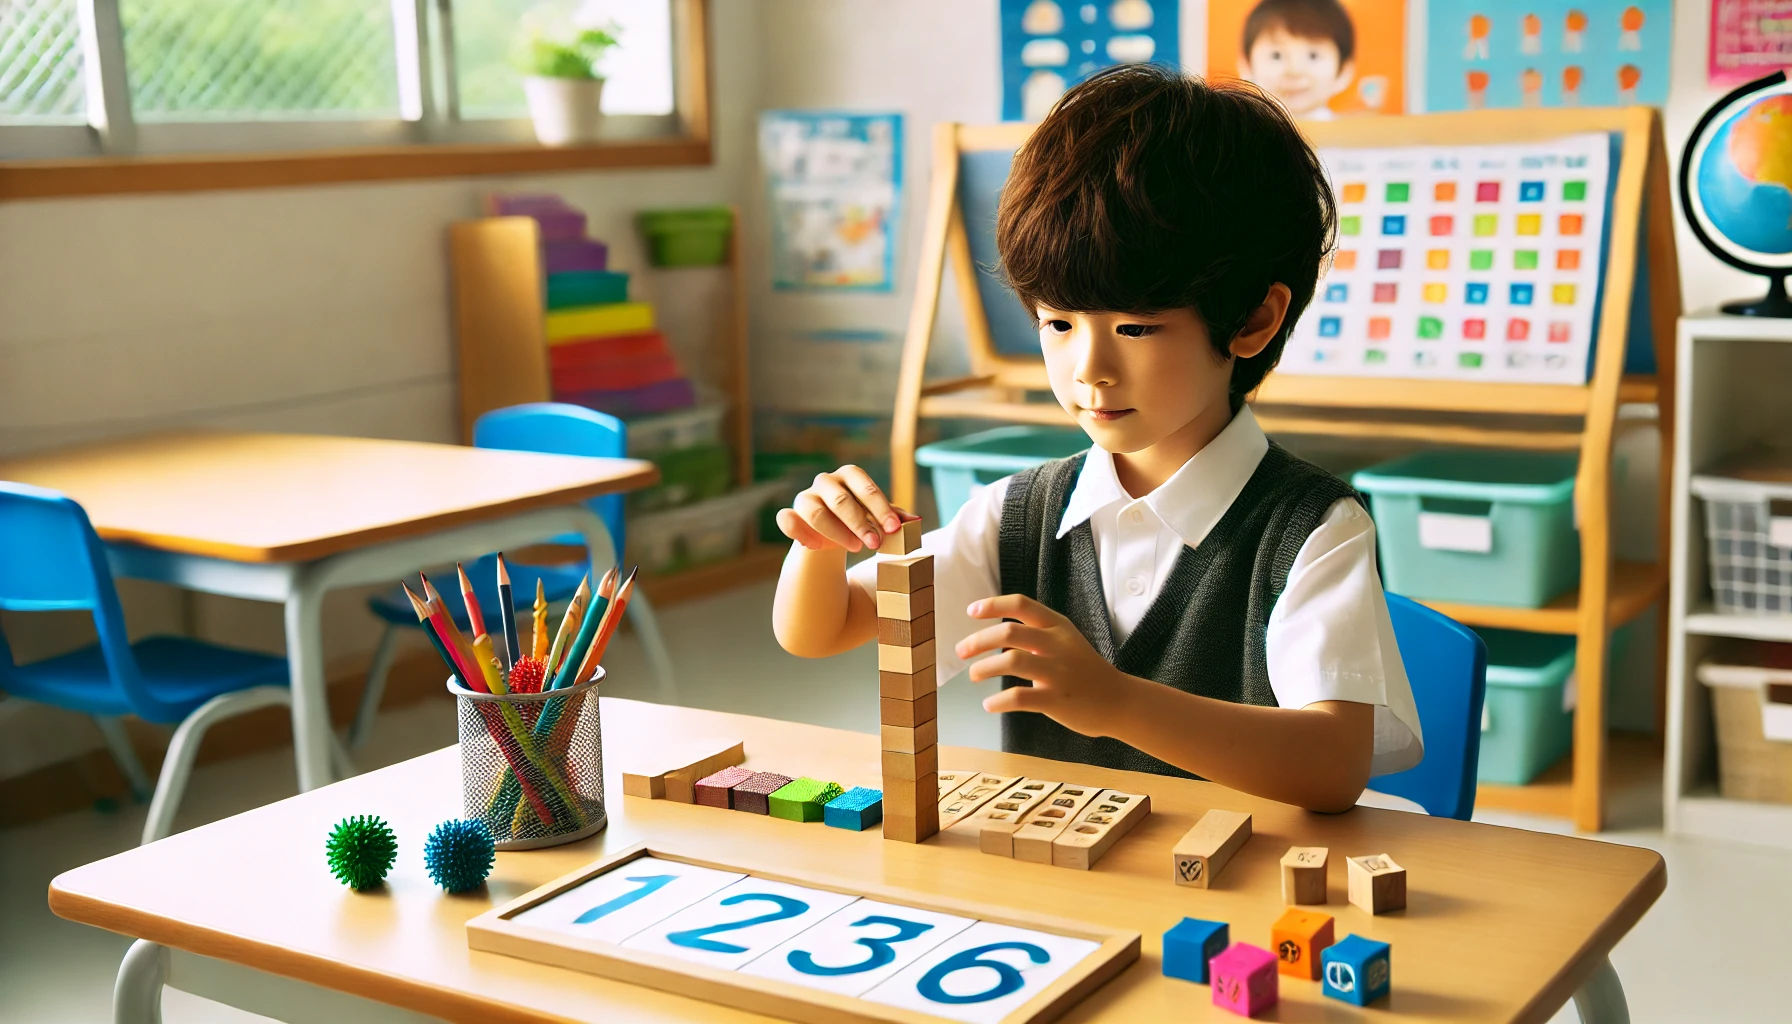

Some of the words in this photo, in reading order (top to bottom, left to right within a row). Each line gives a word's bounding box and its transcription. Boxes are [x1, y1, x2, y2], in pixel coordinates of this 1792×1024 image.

[573, 874, 677, 925] 1
[666, 892, 810, 954] 2
[786, 915, 935, 977] 3
[916, 941, 1051, 1004] 6
